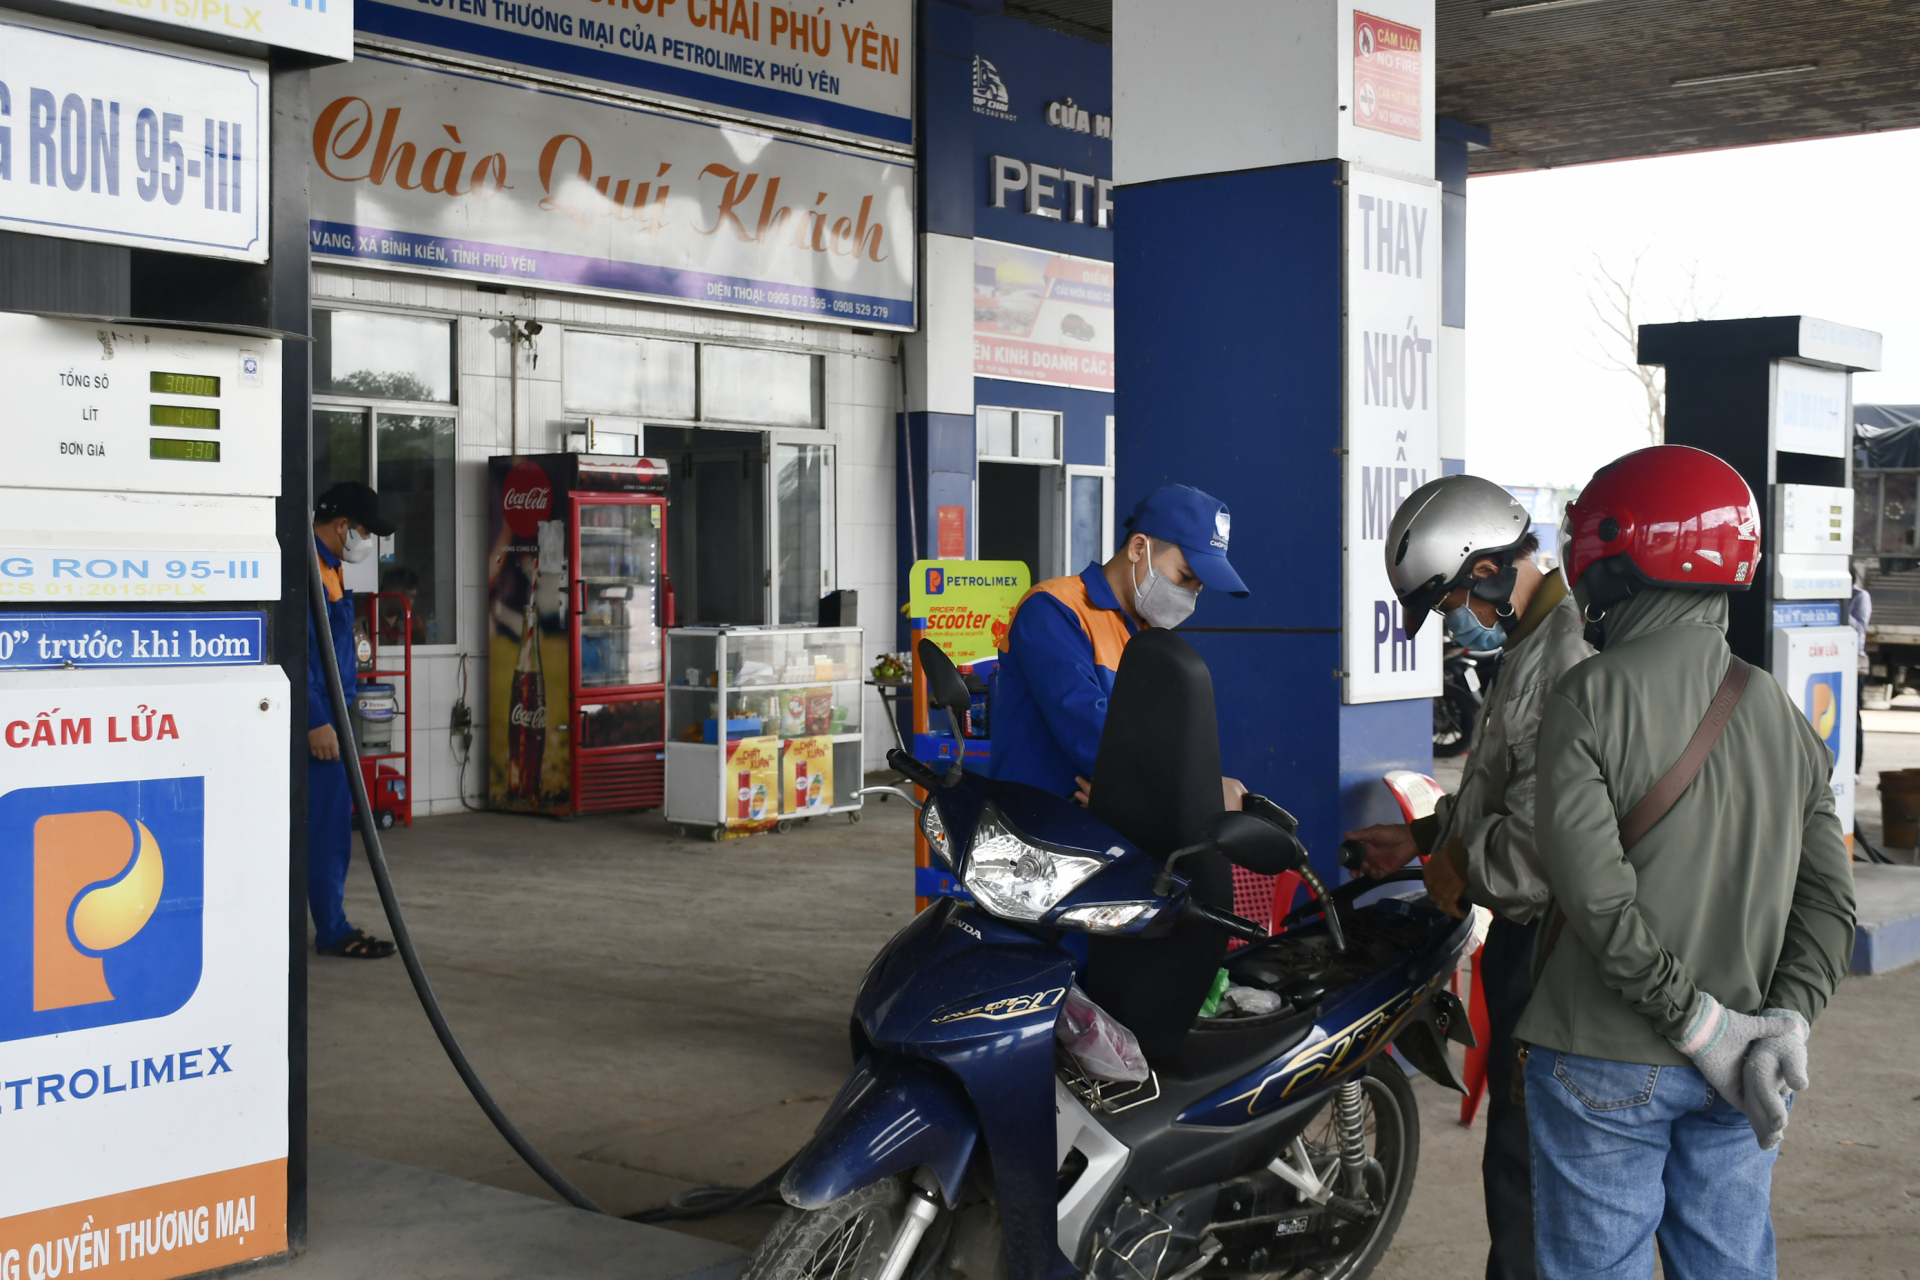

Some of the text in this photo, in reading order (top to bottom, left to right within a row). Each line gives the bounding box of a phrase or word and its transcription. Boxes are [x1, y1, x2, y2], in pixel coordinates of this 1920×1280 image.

[492, 0, 572, 36] THƯƠNG
[579, 18, 614, 49] MẠI
[619, 24, 657, 54] CỦA
[663, 37, 765, 80] PETROLIMEX
[770, 62, 803, 87] PHÚ
[808, 69, 840, 95] YÊN
[770, 7, 831, 58] PHÚ
[841, 21, 899, 76] YÊN
[1377, 52, 1419, 75] NO FIRE
[1046, 97, 1113, 139] CỬA H
[29, 87, 120, 196] RON
[136, 107, 242, 214] 95-III
[312, 96, 888, 263] Chào Quý Khách
[359, 235, 378, 253] XÃ
[381, 238, 412, 258] BÌNH
[415, 240, 448, 264] KIẾN,
[452, 244, 480, 266] TỈNH
[484, 251, 508, 269] PHÚ
[511, 254, 536, 272] YÊN
[1358, 193, 1428, 279] THAY
[707, 282, 732, 299] ĐIỆN
[733, 286, 766, 305] THOẠI:
[767, 292, 790, 305] 0905
[810, 297, 827, 310] 595
[855, 303, 871, 316] 529
[872, 305, 889, 318] 279
[60, 367, 91, 388] TỔNG
[995, 345, 1029, 366] KINH
[1032, 351, 1078, 372] DOANH
[1081, 355, 1107, 375] CÁC
[1364, 315, 1432, 411] NHỚT
[82, 405, 99, 421] LÍT
[60, 441, 105, 457] ĐƠN GIÁ
[504, 487, 550, 510] Coca-Cola
[1362, 429, 1426, 541] MIỄ
[0, 557, 259, 579] G RON 95-III
[946, 576, 1018, 587] PETROLIMEX
[45, 583, 207, 597] 01:2015/PLX
[926, 610, 992, 630] scooter
[38, 630, 123, 660] trước
[131, 630, 181, 659] khi
[189, 630, 251, 659] bơm
[5, 704, 180, 748] CẤM LỬA
[948, 917, 982, 940] ONDA
[0, 1044, 233, 1114] TROLIMEX
[0, 1195, 256, 1280] G QUYỀN THƯƠNG MẠI
